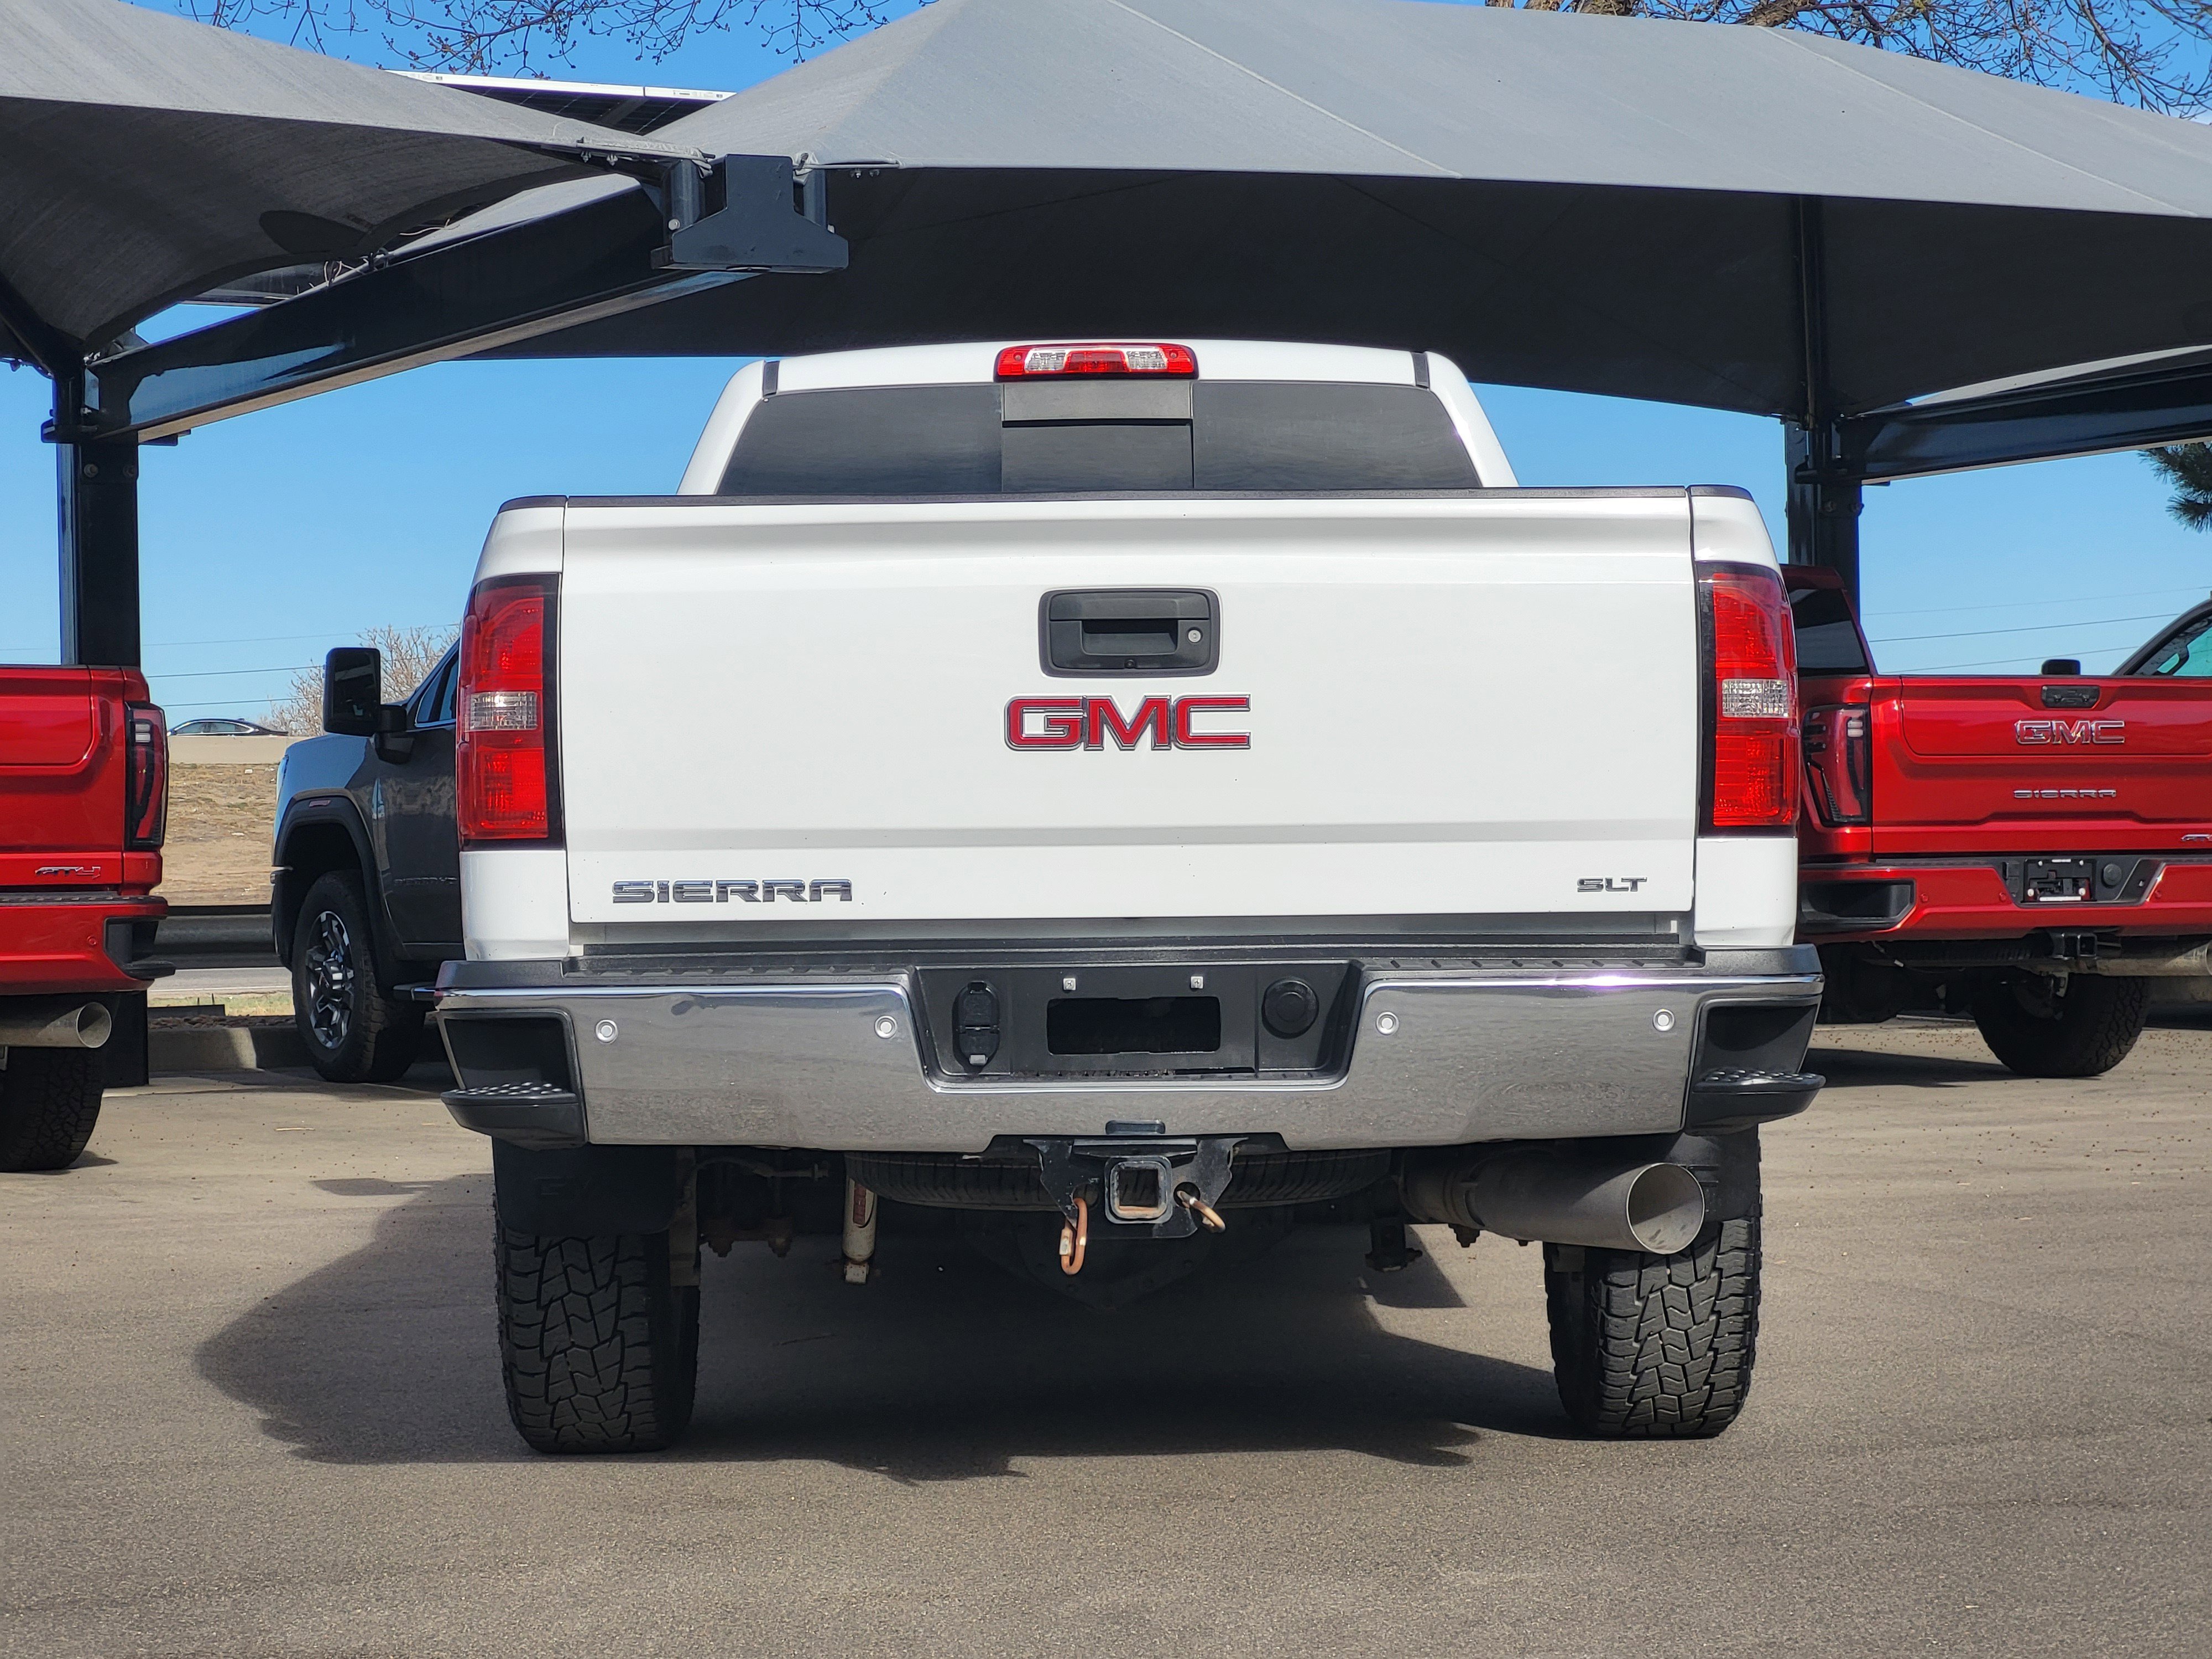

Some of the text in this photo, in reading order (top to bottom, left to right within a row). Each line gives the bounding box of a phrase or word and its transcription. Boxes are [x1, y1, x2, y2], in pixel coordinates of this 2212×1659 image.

[1004, 694, 1251, 751] GMC
[2014, 719, 2125, 744] GMC
[2013, 789, 2117, 799] SIERRA
[612, 879, 853, 903] SIERRA
[1577, 877, 1647, 893] SLT
